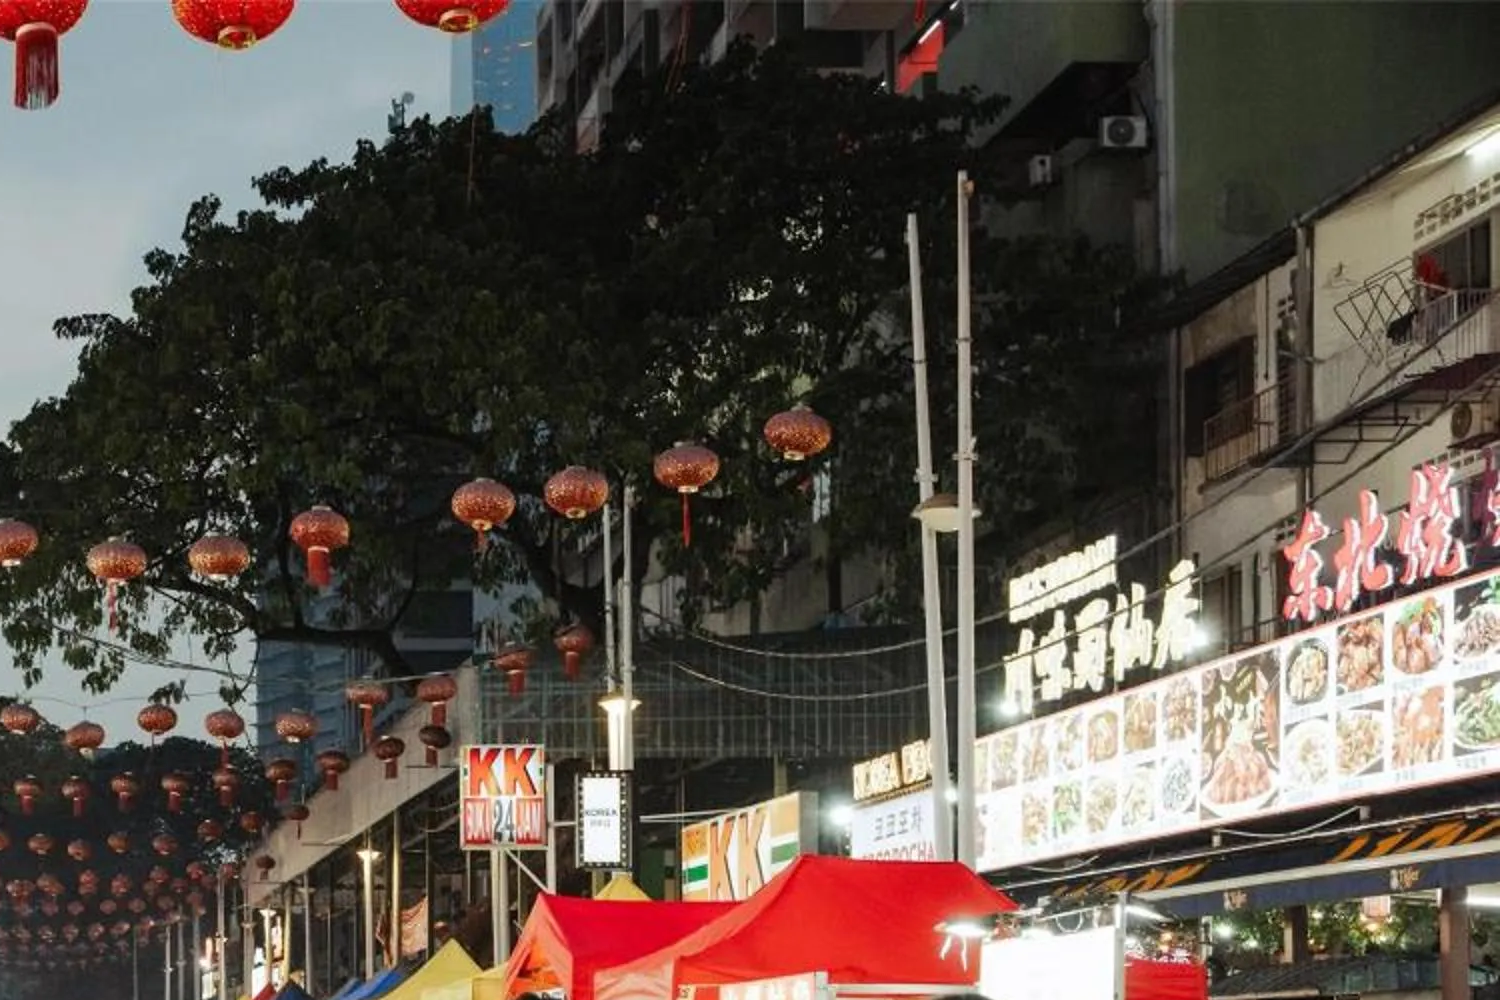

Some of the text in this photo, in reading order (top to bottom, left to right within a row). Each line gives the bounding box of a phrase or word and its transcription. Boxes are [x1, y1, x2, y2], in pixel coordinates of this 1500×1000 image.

[1284, 462, 1500, 621] 东北烧
[469, 747, 537, 797] KK
[493, 799, 515, 842] 24
[710, 805, 769, 900] KK
